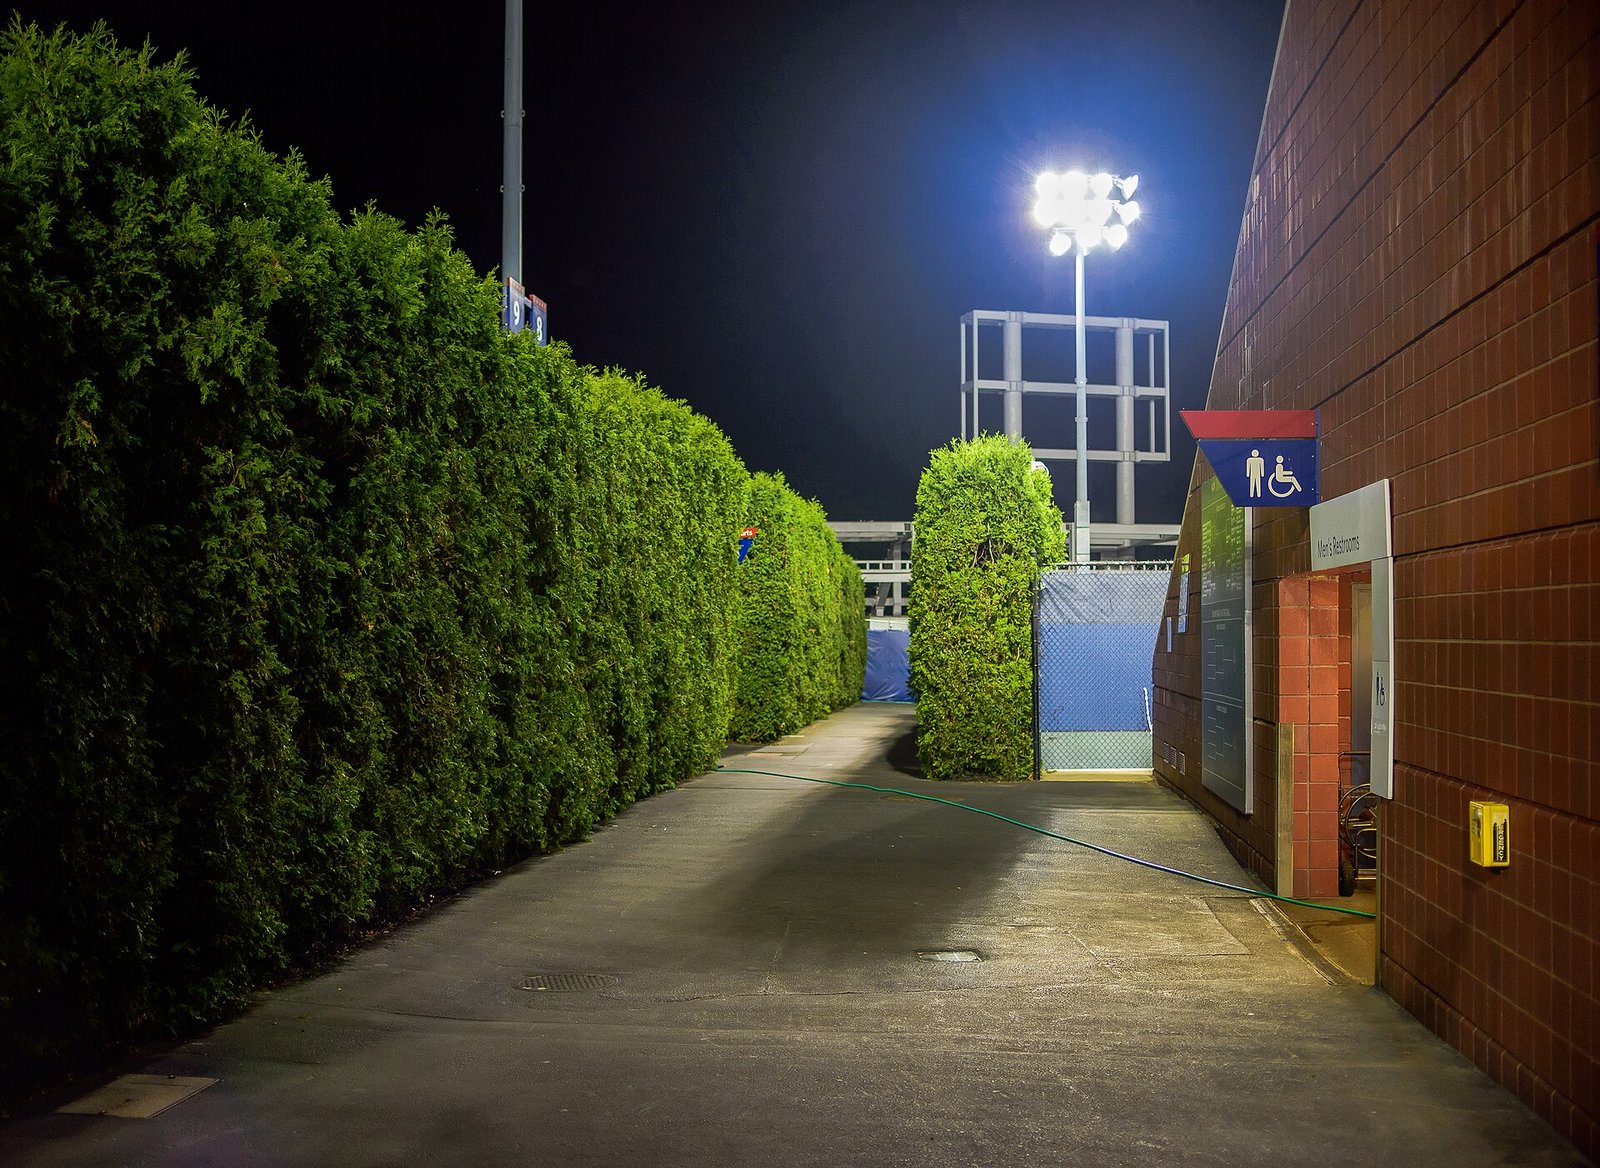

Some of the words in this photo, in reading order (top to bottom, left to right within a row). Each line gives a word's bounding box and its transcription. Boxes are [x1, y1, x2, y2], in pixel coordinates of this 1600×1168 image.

[513, 300, 520, 326] 9
[536, 316, 543, 341] 8
[1317, 538, 1333, 558] Men's
[1333, 536, 1360, 556] Restrooms
